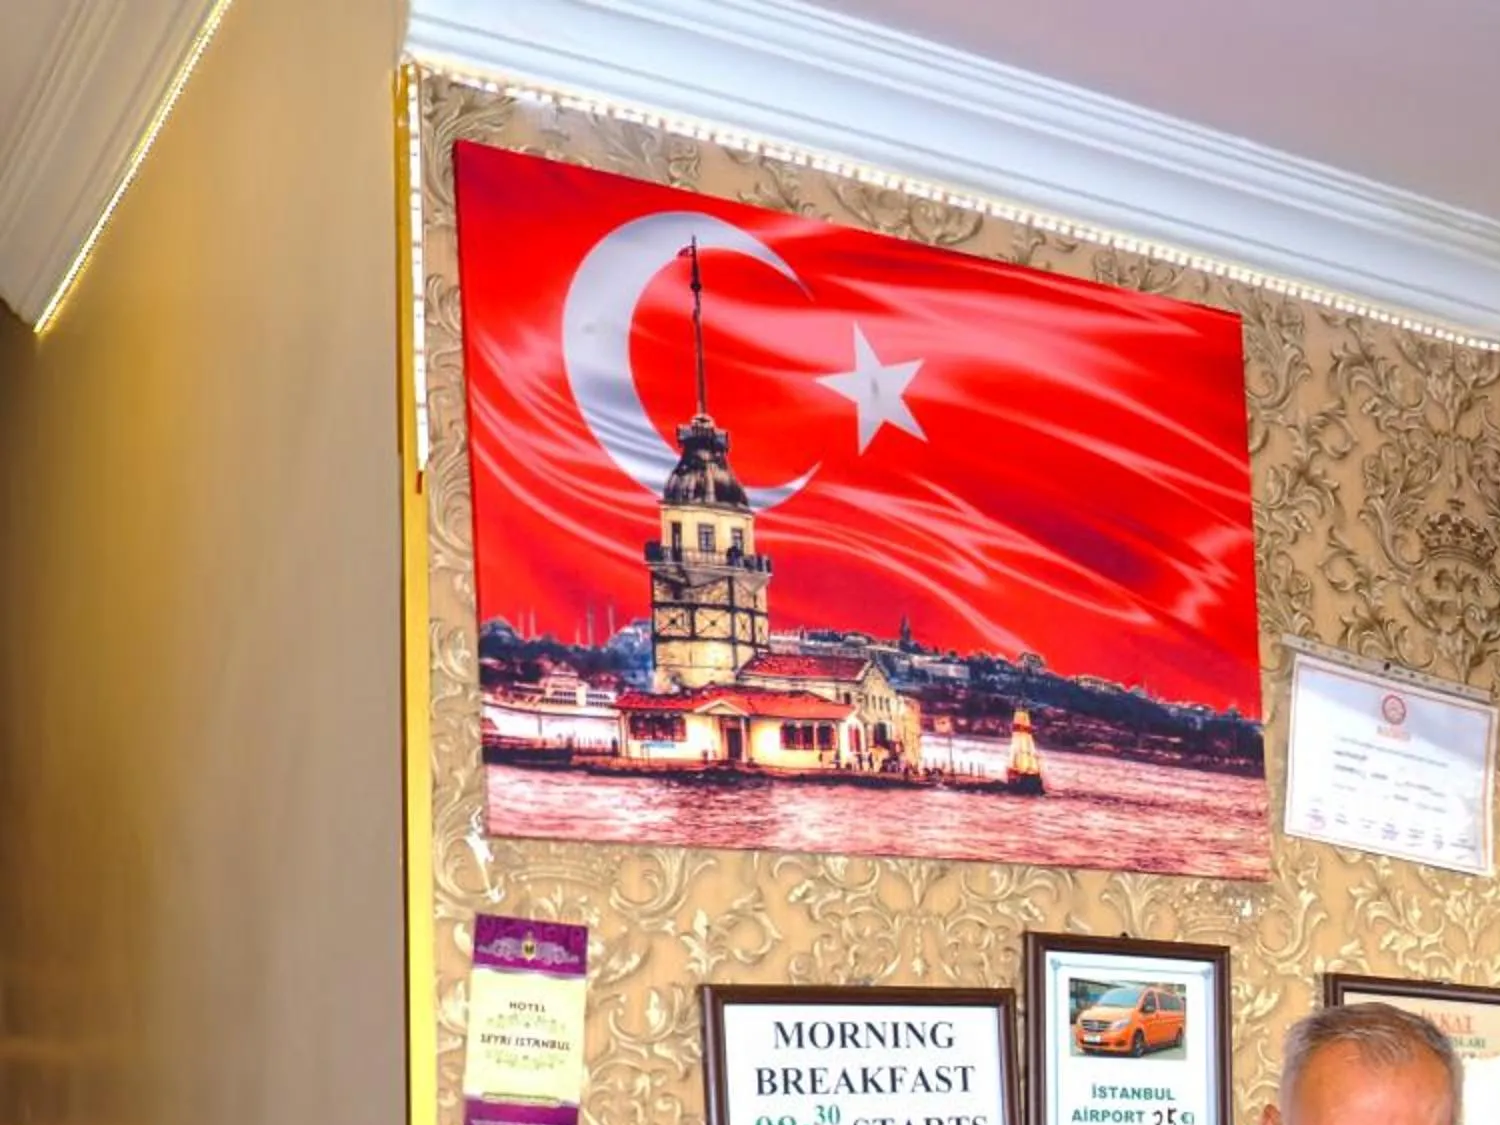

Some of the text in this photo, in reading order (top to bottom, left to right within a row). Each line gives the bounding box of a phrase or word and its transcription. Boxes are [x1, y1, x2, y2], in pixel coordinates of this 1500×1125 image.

[773, 1020, 956, 1050] MORNING
[755, 1065, 976, 1097] BREAKFAST
[1071, 1106, 1146, 1124] AİRPORT
